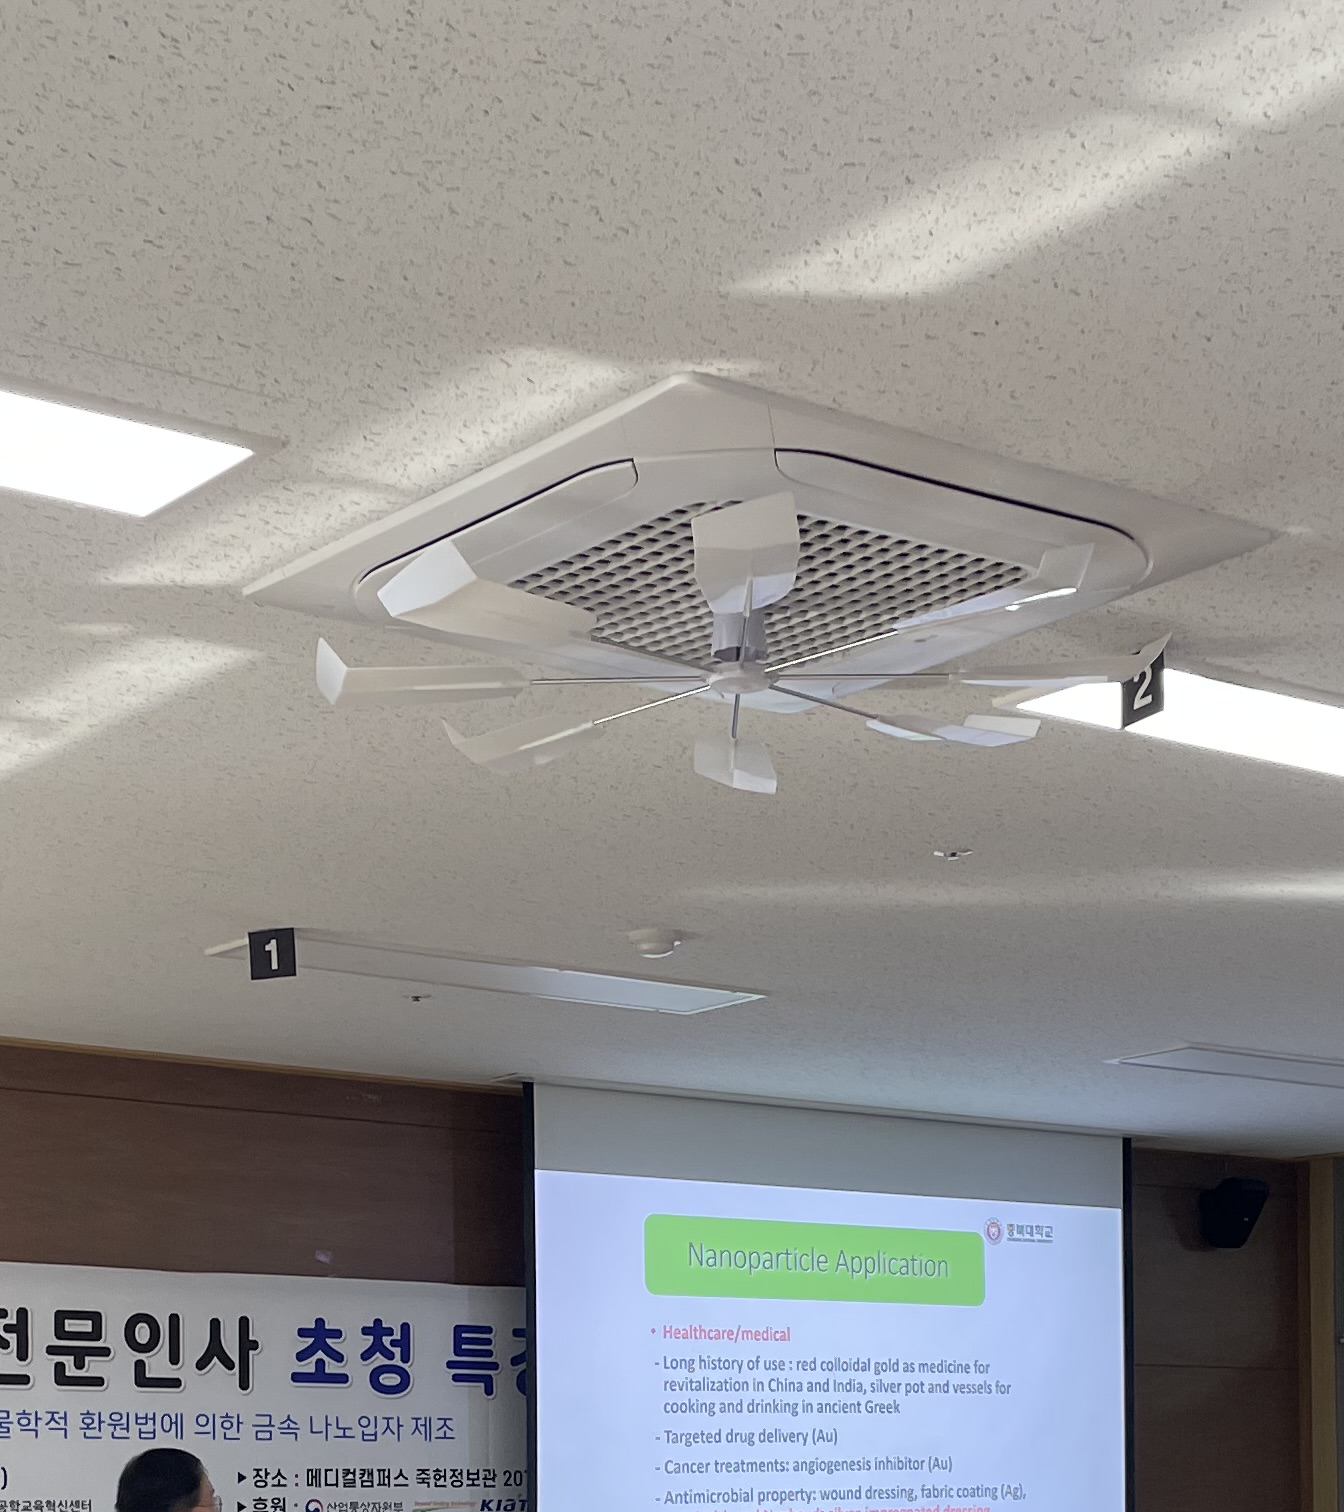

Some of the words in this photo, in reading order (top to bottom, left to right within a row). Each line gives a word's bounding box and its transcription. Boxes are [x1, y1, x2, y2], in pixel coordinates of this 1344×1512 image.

[1133, 665, 1153, 710] 2
[264, 938, 279, 970] 1
[688, 1241, 829, 1276] Nanoparticle
[835, 1249, 949, 1280] Application
[663, 1324, 791, 1344] Healthcare/medical
[290, 1317, 411, 1397] 초청
[663, 1355, 696, 1374] Long
[699, 1355, 743, 1374] history
[747, 1355, 761, 1371] of
[764, 1359, 786, 1371] use
[796, 1357, 817, 1372] red
[820, 1357, 871, 1372] colloidal
[874, 1358, 900, 1376] gold
[902, 1361, 915, 1373] as
[918, 1359, 971, 1374] medicine
[973, 1359, 991, 1374] for
[663, 1376, 750, 1392] revitalization
[753, 1377, 765, 1392] in
[768, 1377, 803, 1392] China
[806, 1378, 830, 1393] and
[833, 1378, 867, 1395] India,
[870, 1379, 902, 1393] silver
[904, 1380, 926, 1396] pot
[927, 1379, 950, 1394] and
[952, 1380, 993, 1395] vessels
[995, 1380, 1012, 1395] for
[663, 1398, 716, 1417] cooking
[719, 1399, 743, 1414] and
[747, 1399, 799, 1417] drinking
[802, 1399, 814, 1414] in
[816, 1399, 862, 1414] ancient
[864, 1399, 901, 1414] Greek
[78, 1409, 185, 1442] 환원법에
[194, 1412, 245, 1442] 의한
[252, 1413, 301, 1442] 금속
[308, 1414, 405, 1443] 나노입자
[410, 1415, 458, 1443] 제조
[664, 1428, 722, 1447] Targeted
[725, 1428, 756, 1447] drug
[758, 1428, 809, 1446] delivery
[812, 1428, 838, 1446] (Au)
[664, 1459, 711, 1474] Cancer
[714, 1459, 790, 1474] treatments:
[792, 1457, 872, 1475] angiogenesis
[874, 1456, 926, 1471] inhibitor
[928, 1456, 953, 1473] (Au)
[252, 1468, 288, 1489] 장소
[306, 1468, 410, 1489] 메디컬캠퍼스
[415, 1468, 498, 1489] 죽헌정보관
[503, 1469, 528, 1488] 20
[664, 1487, 754, 1505] Antimicrobial
[757, 1487, 817, 1505] property:
[820, 1485, 862, 1501] wound
[865, 1485, 918, 1502] dressing,
[920, 1484, 955, 1499] fabric
[956, 1484, 999, 1500] coating
